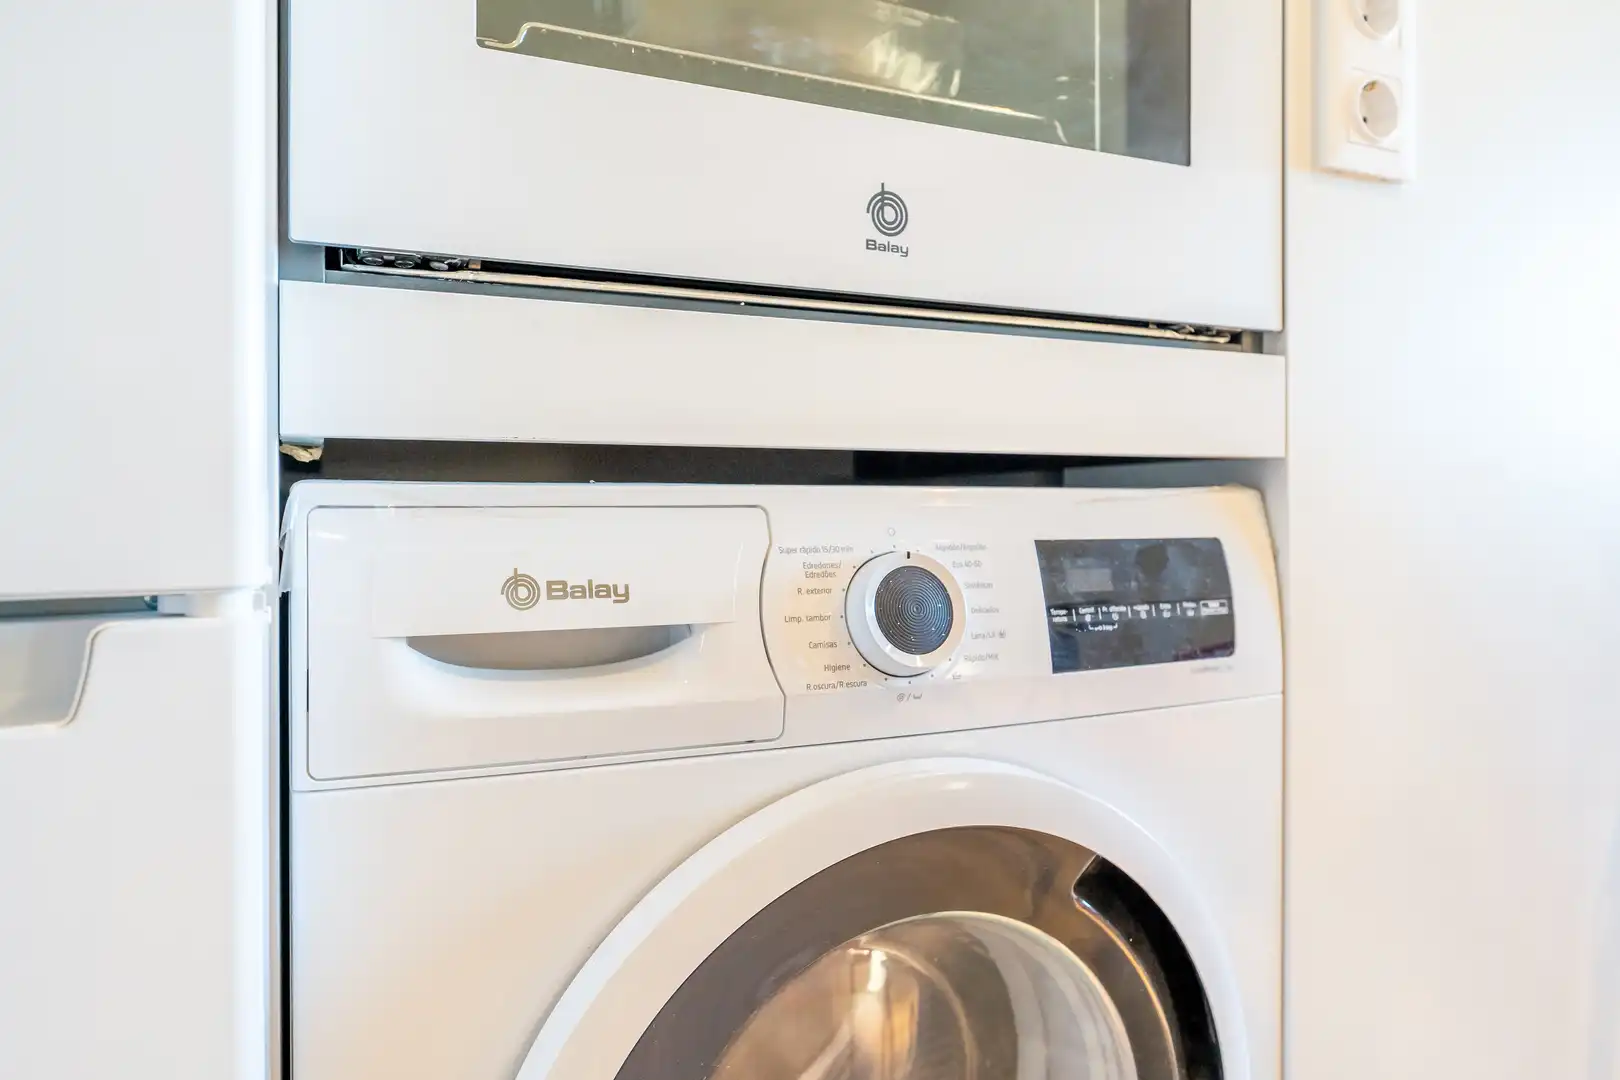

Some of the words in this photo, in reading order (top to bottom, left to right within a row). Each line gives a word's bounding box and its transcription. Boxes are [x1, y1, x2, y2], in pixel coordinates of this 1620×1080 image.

[865, 238, 909, 258] Balay
[545, 578, 631, 604] Balay
[797, 587, 804, 595] R.
[806, 587, 833, 595] exterior
[784, 615, 804, 624] Limp.
[805, 614, 832, 622] tambor
[808, 641, 838, 649] Camisas
[823, 664, 851, 673] Higiene
